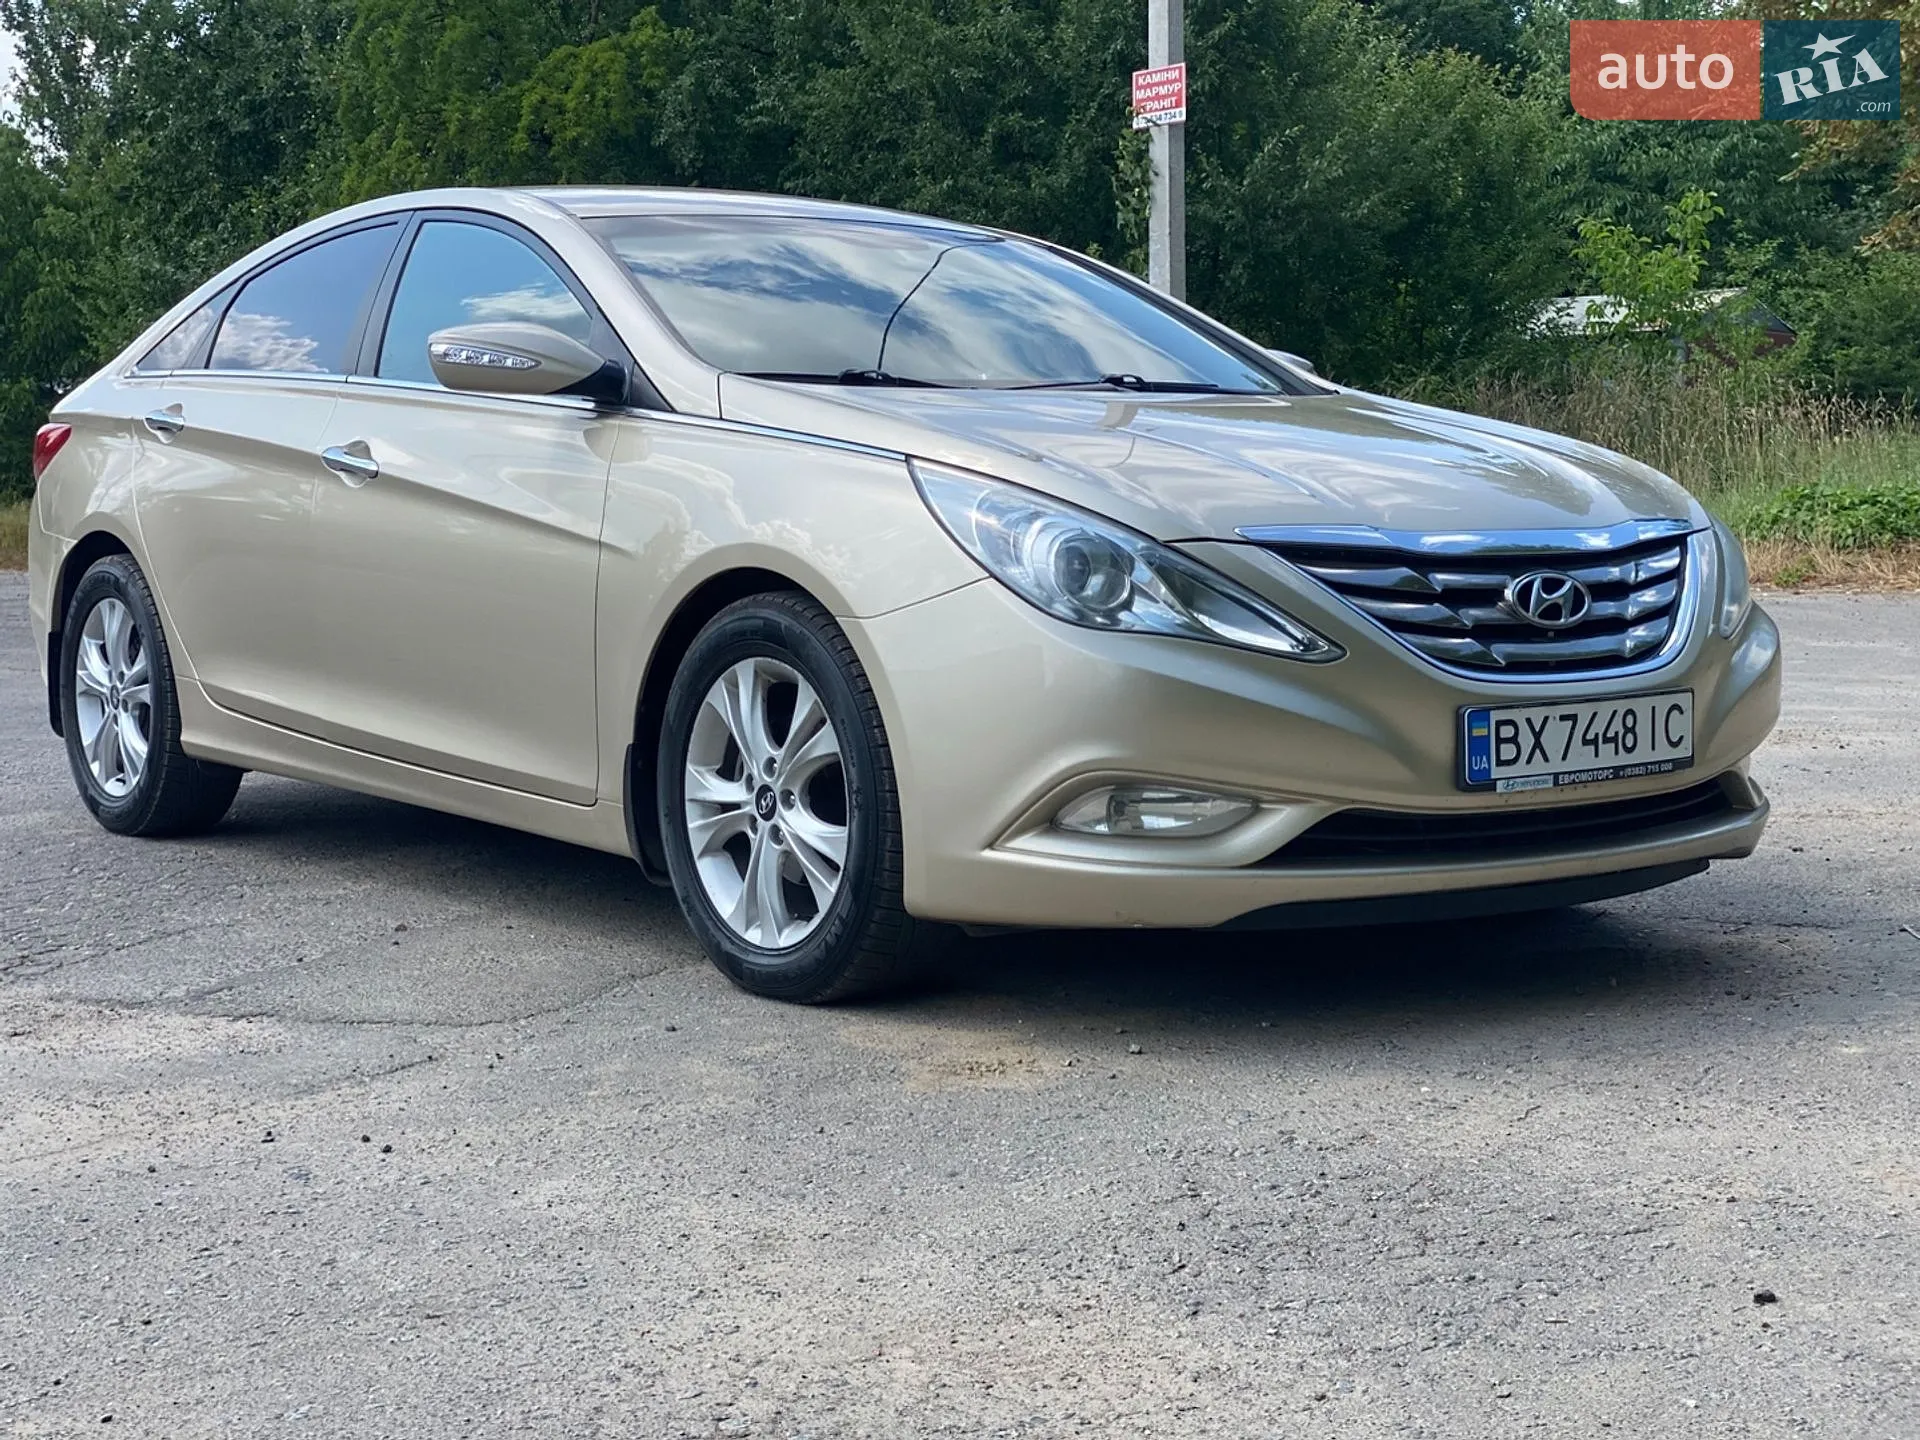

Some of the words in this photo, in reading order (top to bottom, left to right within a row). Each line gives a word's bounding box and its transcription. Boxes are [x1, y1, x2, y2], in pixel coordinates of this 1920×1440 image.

[1137, 69, 1180, 86] КАМІНИ
[1135, 82, 1182, 100] МАРМУР
[1472, 754, 1489, 770] UA
[1558, 769, 1614, 785] ЕВРОМОТОРС
